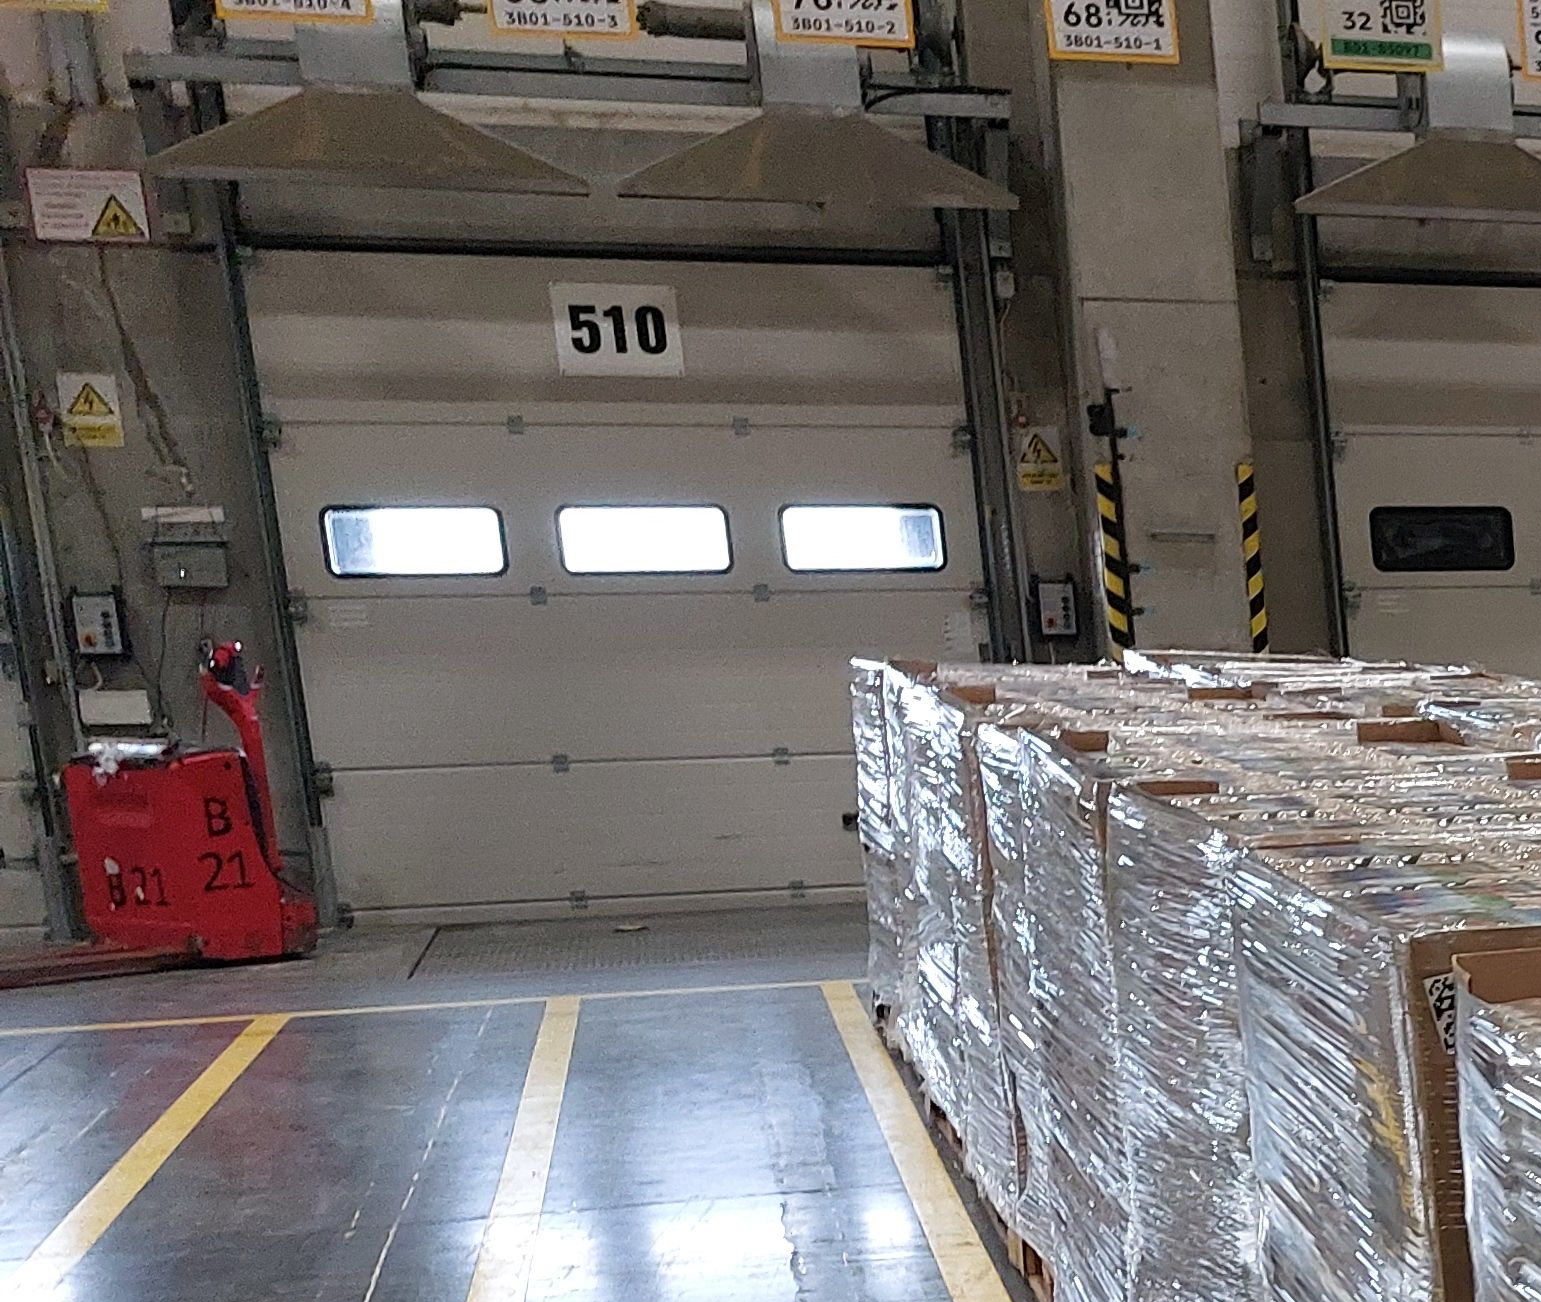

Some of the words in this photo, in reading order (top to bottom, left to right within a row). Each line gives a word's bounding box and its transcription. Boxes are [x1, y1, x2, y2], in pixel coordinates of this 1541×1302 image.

[792, 17, 896, 34] 3B01-510-2
[1063, 1, 1103, 28] 68
[1342, 11, 1373, 31] 32
[1064, 34, 1162, 50] 3B01-510-1
[567, 304, 669, 356] 510
[204, 797, 233, 837] B
[198, 850, 256, 893] 21
